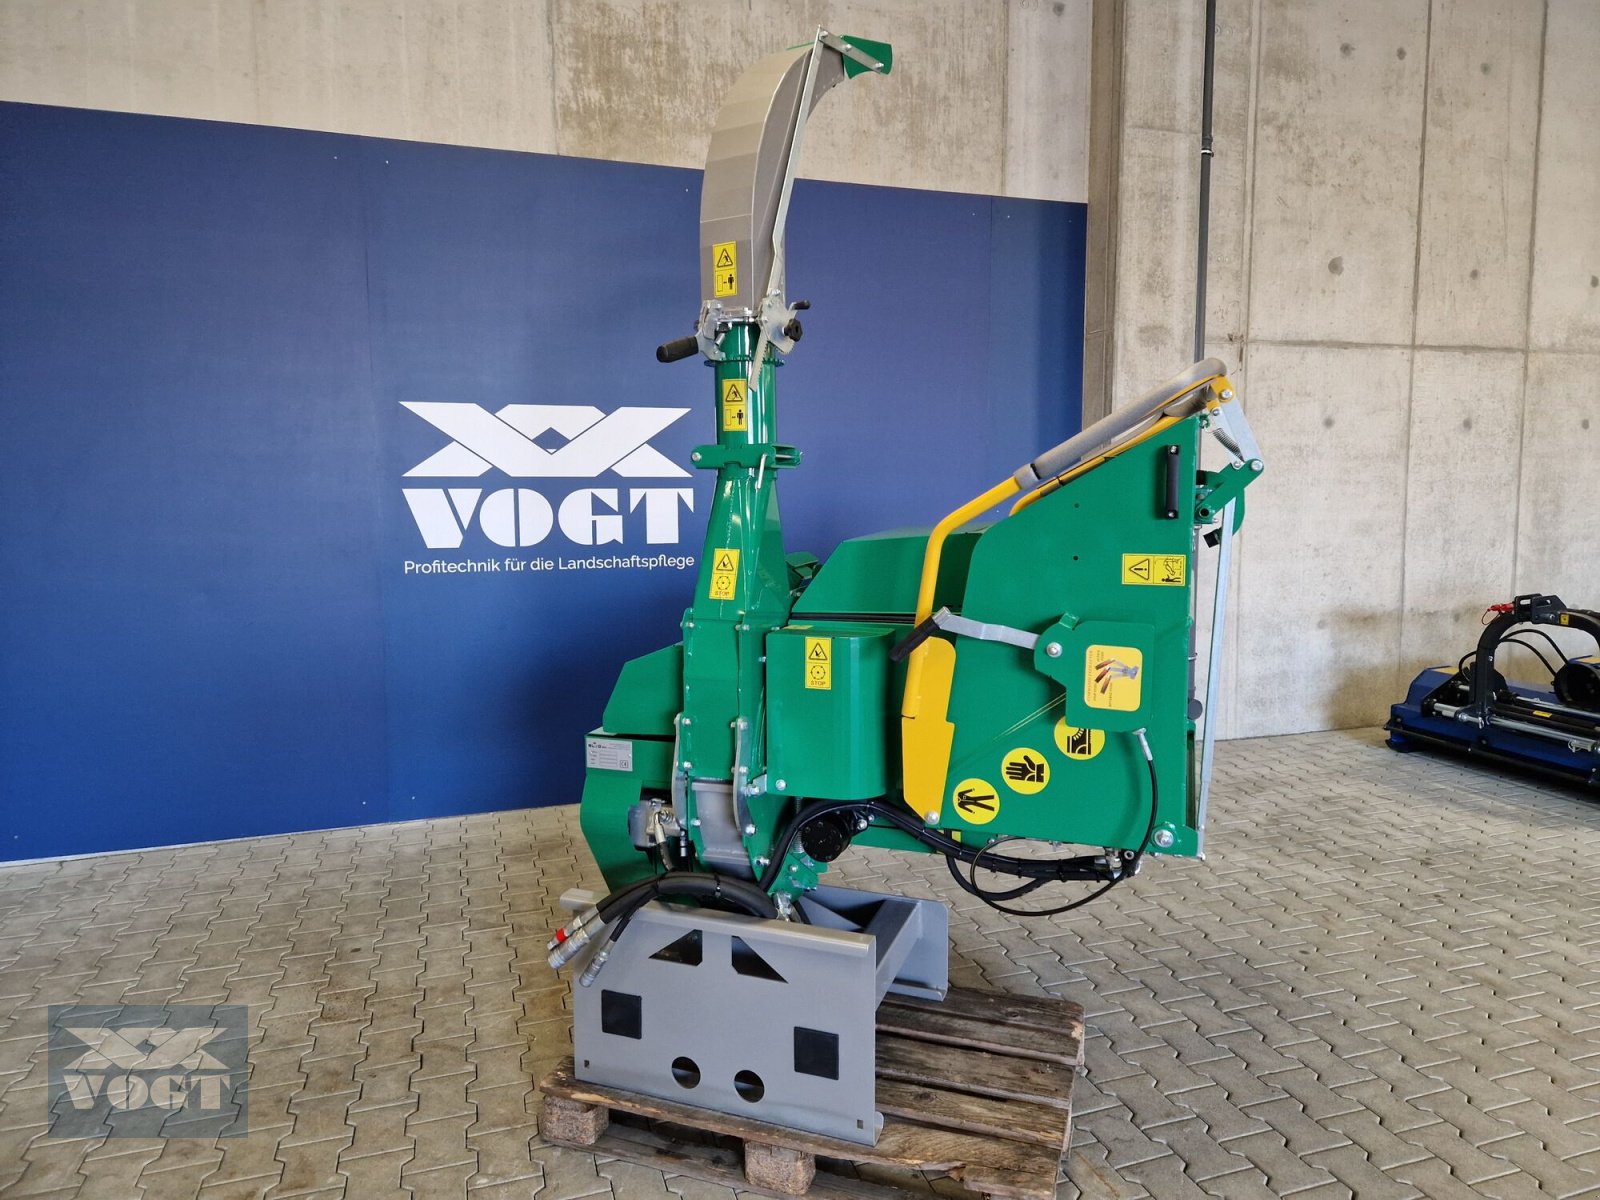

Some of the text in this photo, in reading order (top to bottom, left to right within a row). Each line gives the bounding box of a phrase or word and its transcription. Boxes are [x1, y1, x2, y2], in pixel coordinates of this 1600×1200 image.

[401, 487, 694, 548] VOGT
[403, 553, 695, 575] Profitechnik für die Landschaftspflege
